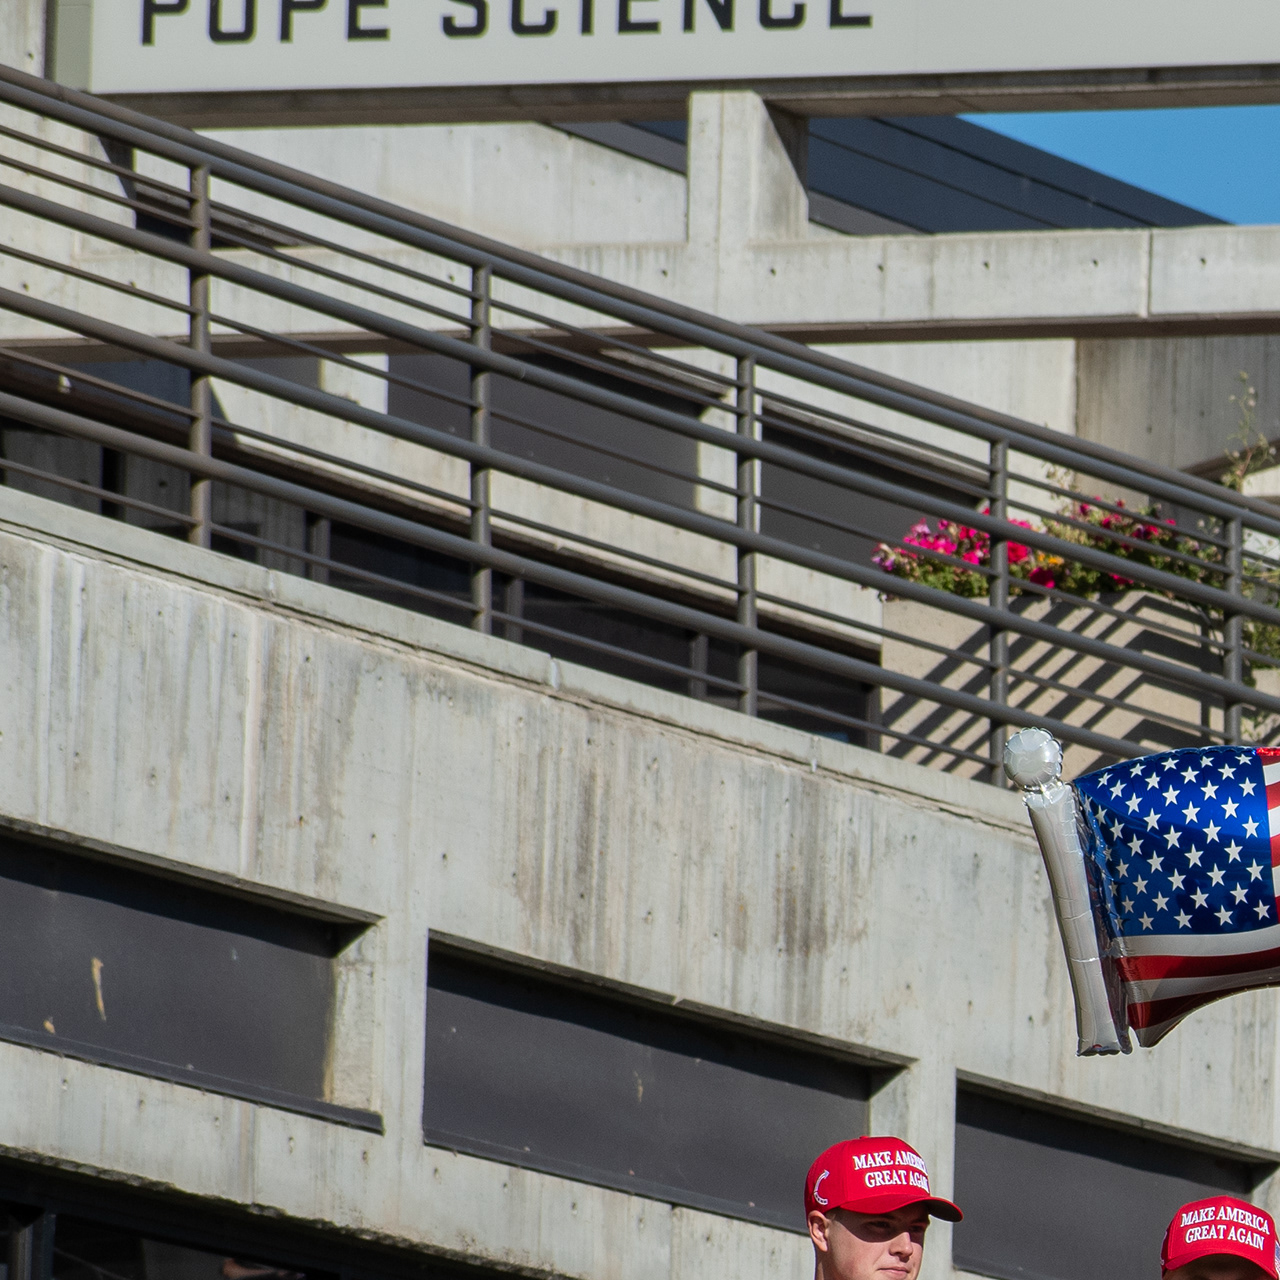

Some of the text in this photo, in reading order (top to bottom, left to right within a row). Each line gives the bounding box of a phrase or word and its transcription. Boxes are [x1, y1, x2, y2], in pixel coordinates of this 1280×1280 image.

[853, 1151, 893, 1170] MAKE
[865, 1170, 907, 1187] GREAT
[1181, 1206, 1270, 1235] MAKE AMERICA
[1185, 1225, 1264, 1251] GREAT AGAIN
